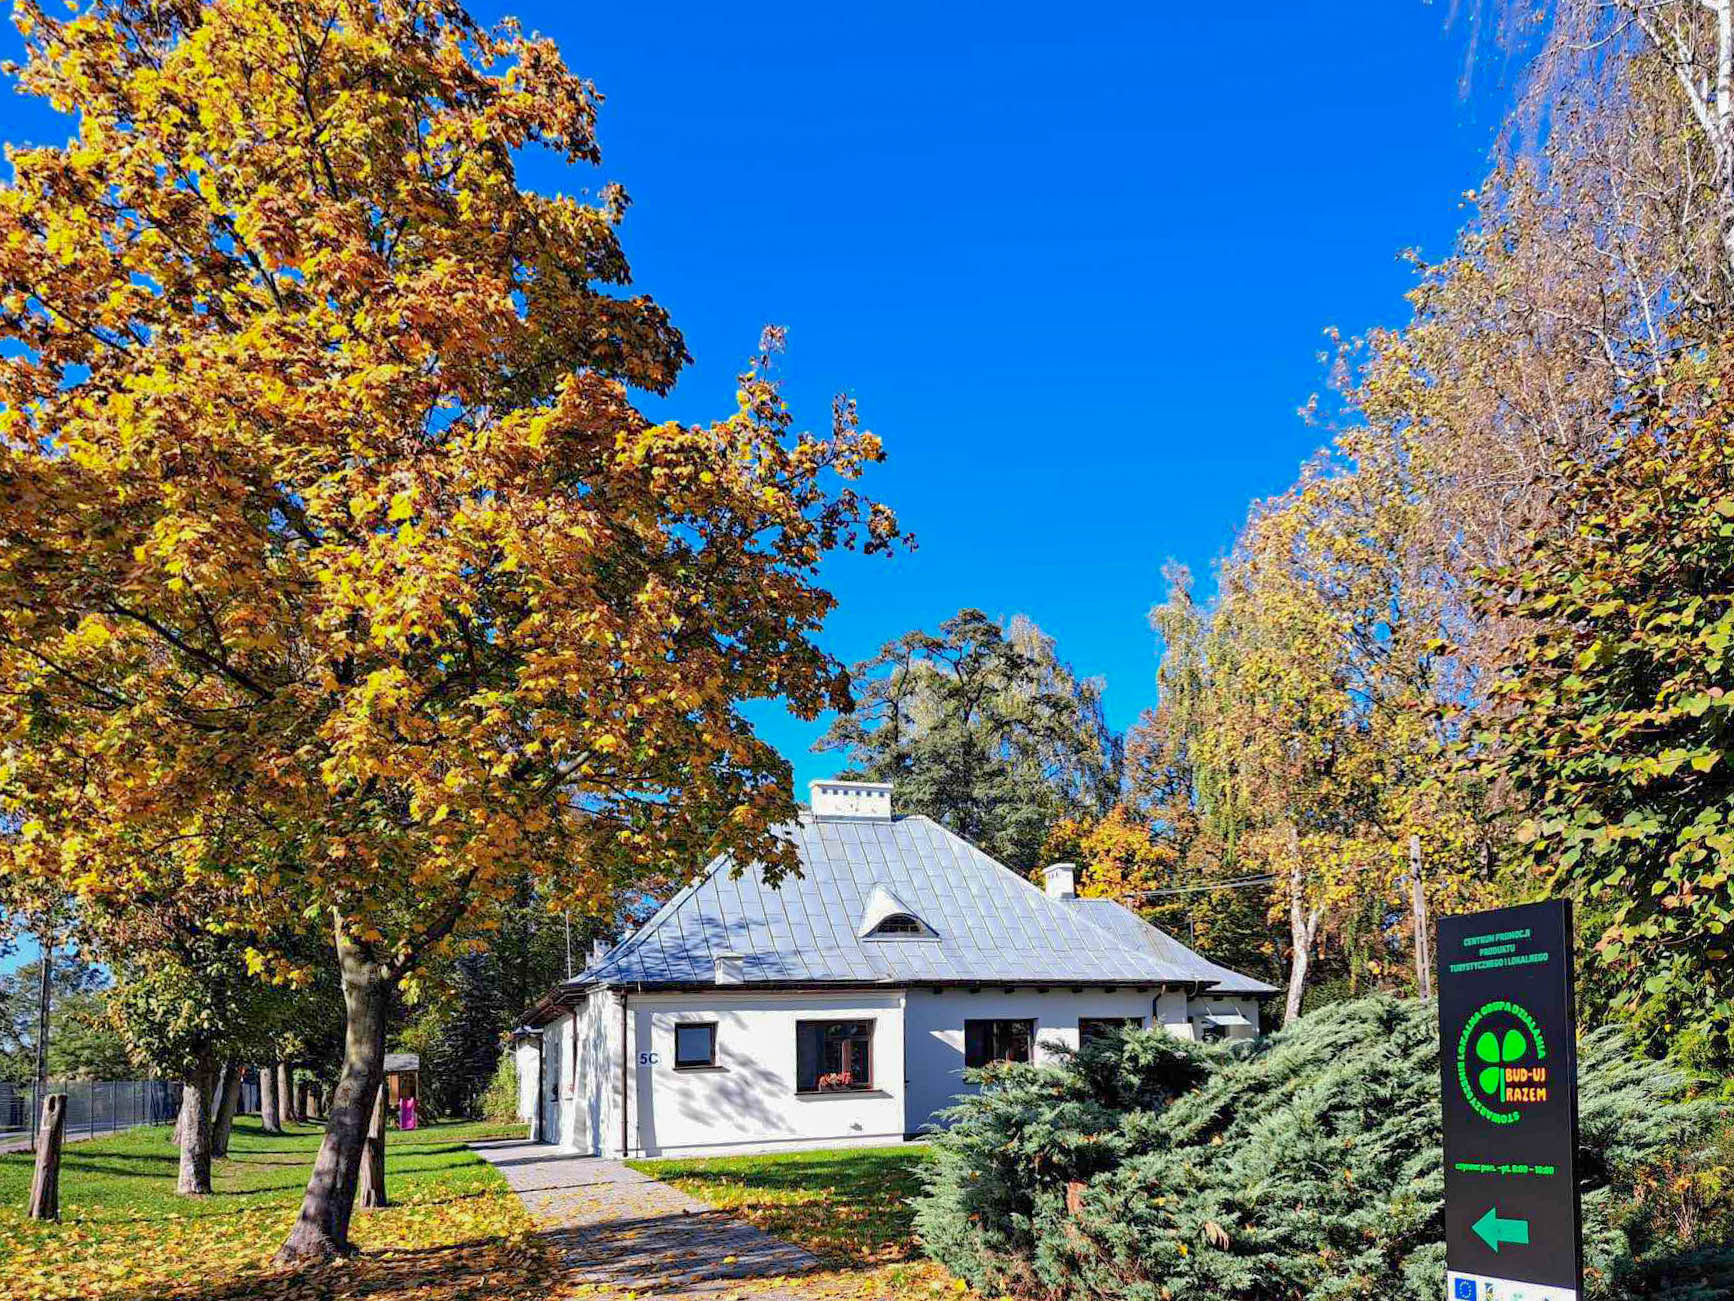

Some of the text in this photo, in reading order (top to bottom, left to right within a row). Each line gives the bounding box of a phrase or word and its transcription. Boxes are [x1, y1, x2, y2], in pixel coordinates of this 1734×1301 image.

[1463, 929, 1530, 946] CENTRUM PROMOCJI
[1479, 944, 1515, 957] PRODUKTU
[1450, 958, 1503, 972] TURYSTYCZNEGO
[1508, 953, 1549, 966] LOKALNEGO
[1457, 1011, 1482, 1060] LOKALNA
[639, 1052, 658, 1065] 5C
[1505, 1067, 1546, 1082] BUD-UJ
[1505, 1087, 1547, 1102] RAZEM
